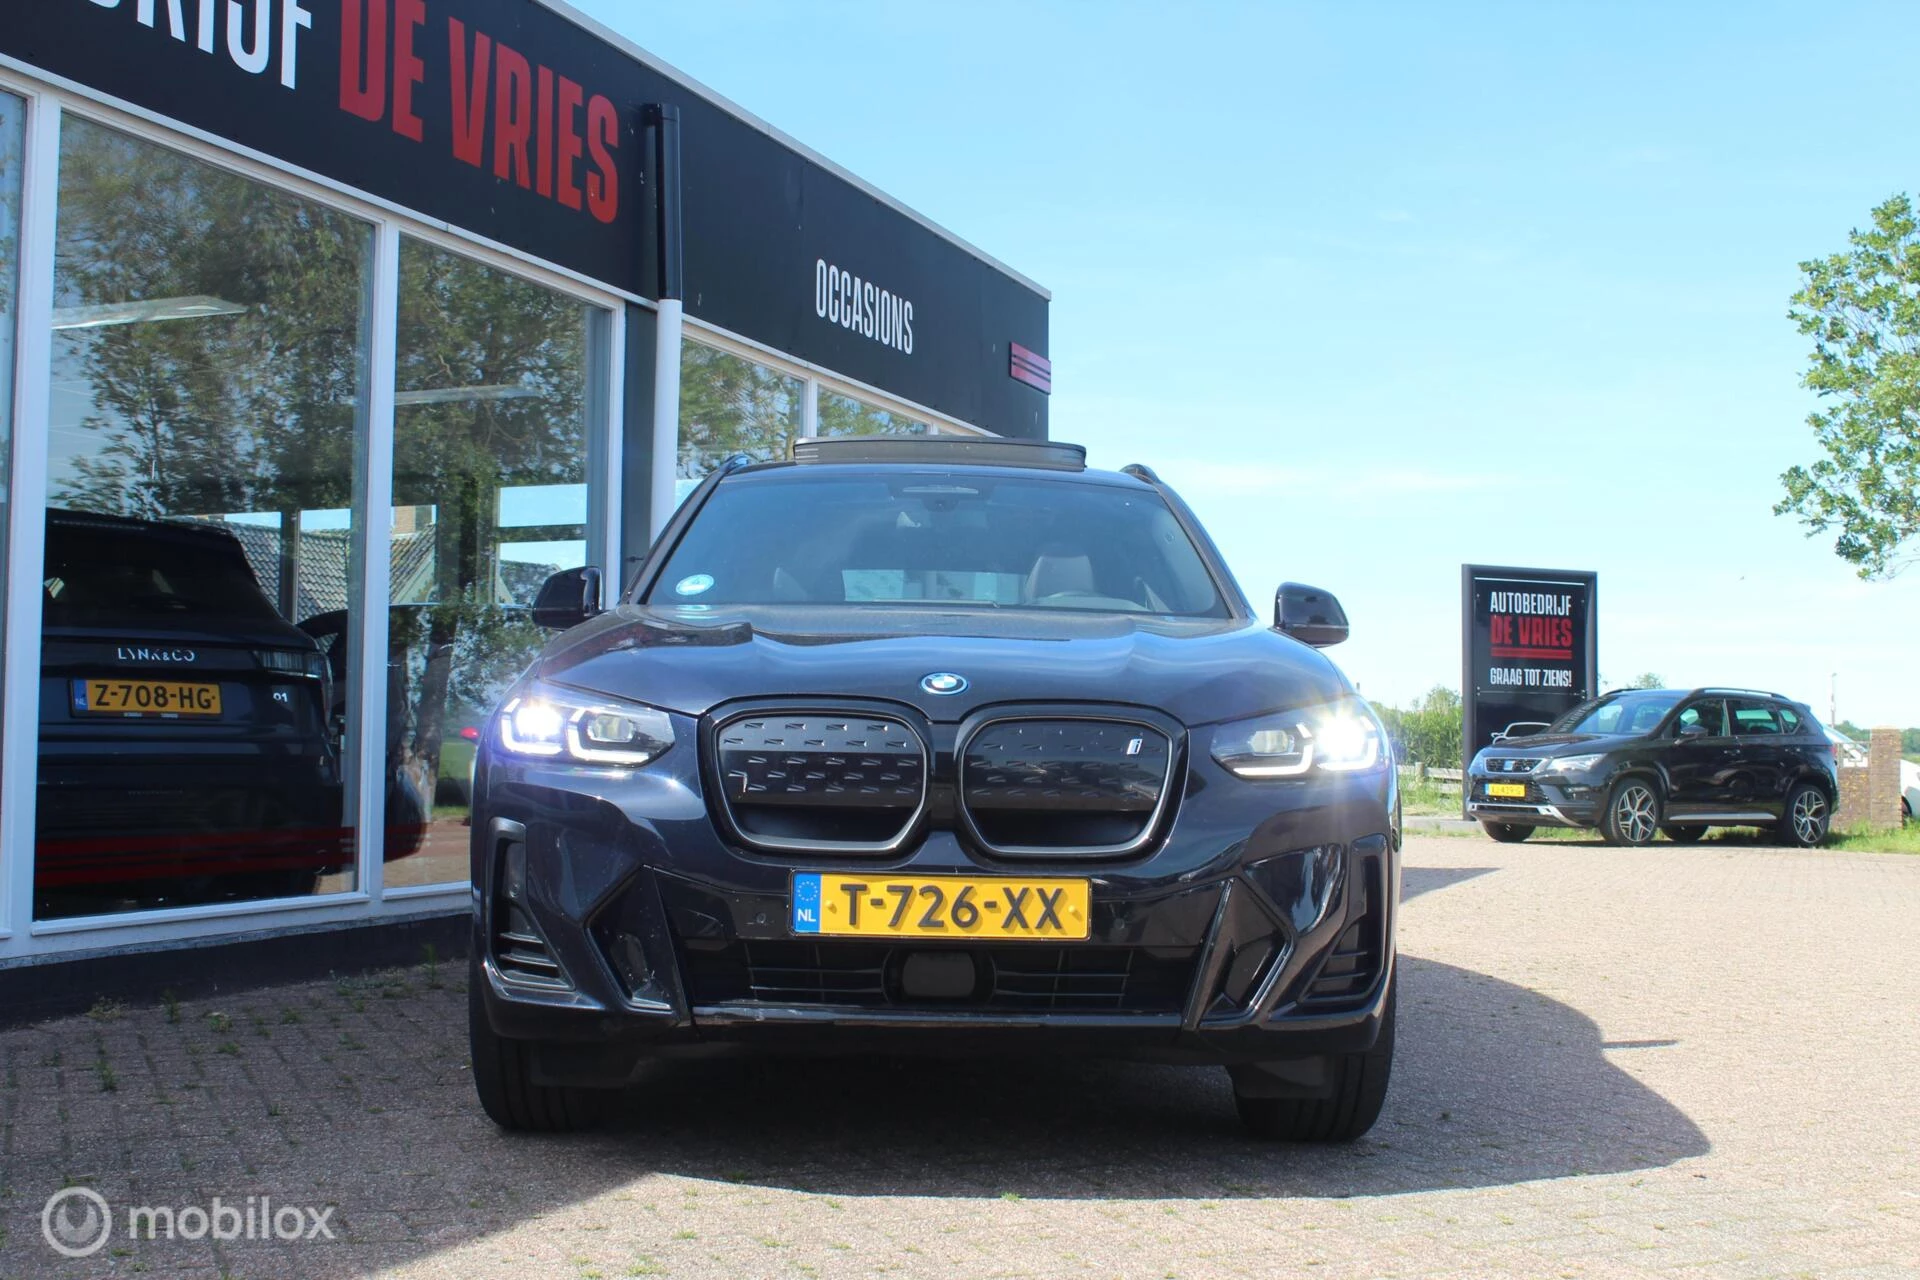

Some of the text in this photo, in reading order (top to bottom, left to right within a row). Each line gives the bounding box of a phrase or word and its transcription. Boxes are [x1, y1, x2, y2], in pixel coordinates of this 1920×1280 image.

[339, 0, 425, 143] DE
[449, 16, 619, 224] VRIES
[815, 258, 913, 355] OCCASIONS
[1490, 591, 1572, 616] AUTOBEDRIJF
[1490, 615, 1573, 647] DE VRIES
[1490, 667, 1572, 688] GRAAG TOT ZIENS!
[95, 684, 212, 710] Z-708-HG
[797, 909, 817, 923] NL
[840, 883, 1063, 930] T-726-XX
